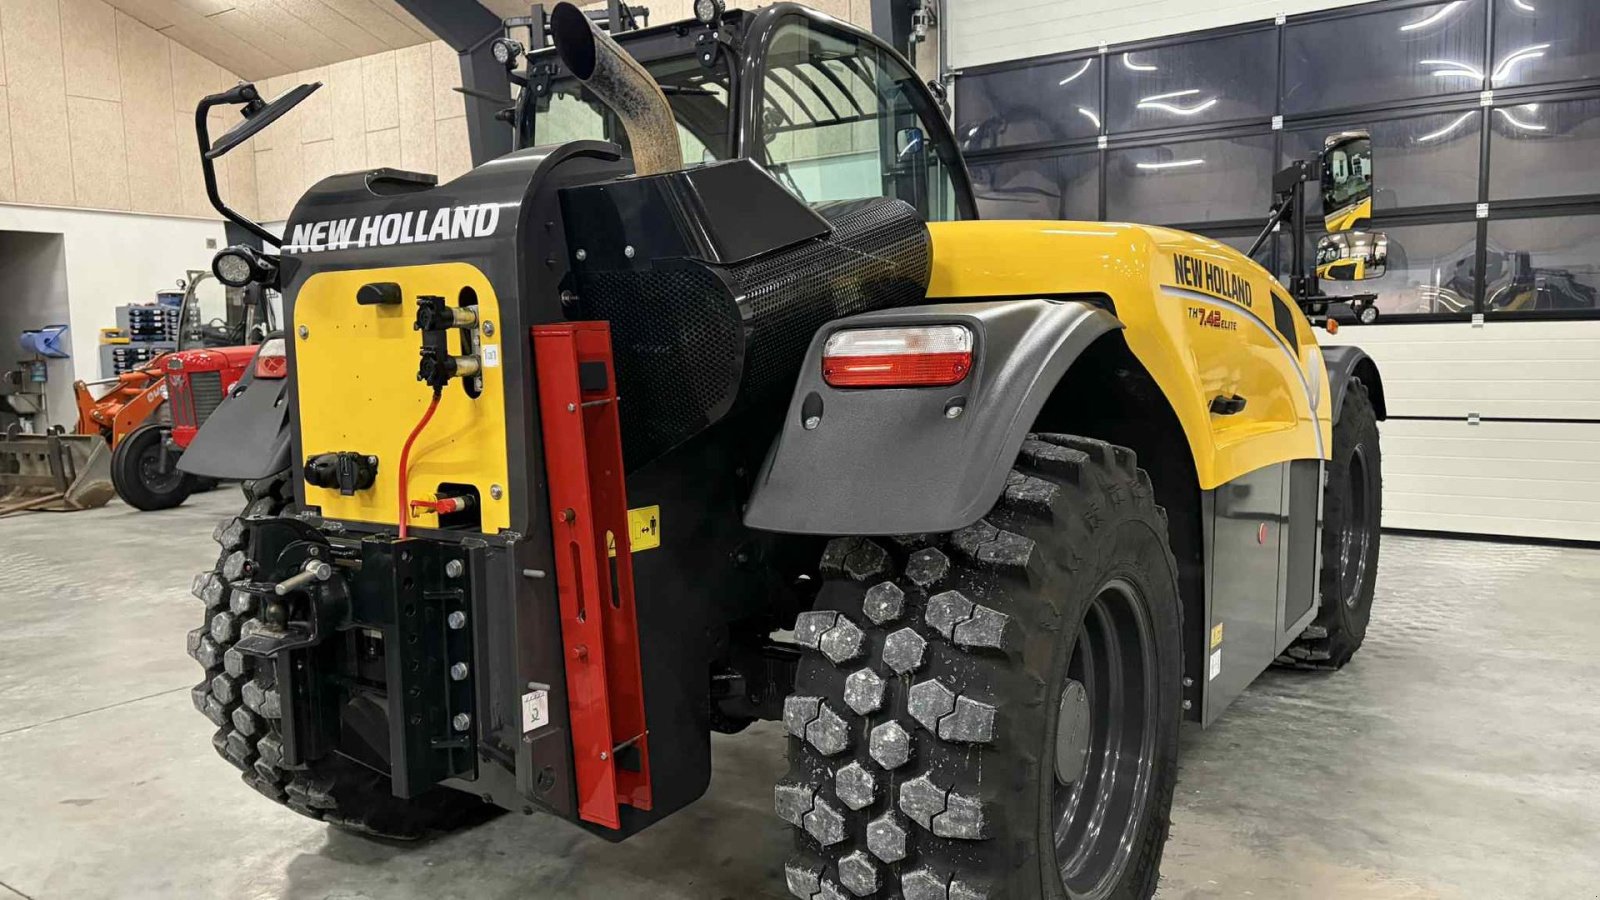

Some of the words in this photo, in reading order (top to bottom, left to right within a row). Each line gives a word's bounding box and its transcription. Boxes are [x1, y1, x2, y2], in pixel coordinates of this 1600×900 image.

[290, 218, 356, 254] NEW
[358, 203, 500, 248] HOLLAND
[1173, 252, 1203, 289] NEW
[1204, 261, 1252, 308] HOLLAND
[1188, 307, 1198, 319] TH
[1220, 319, 1237, 331] ELITE
